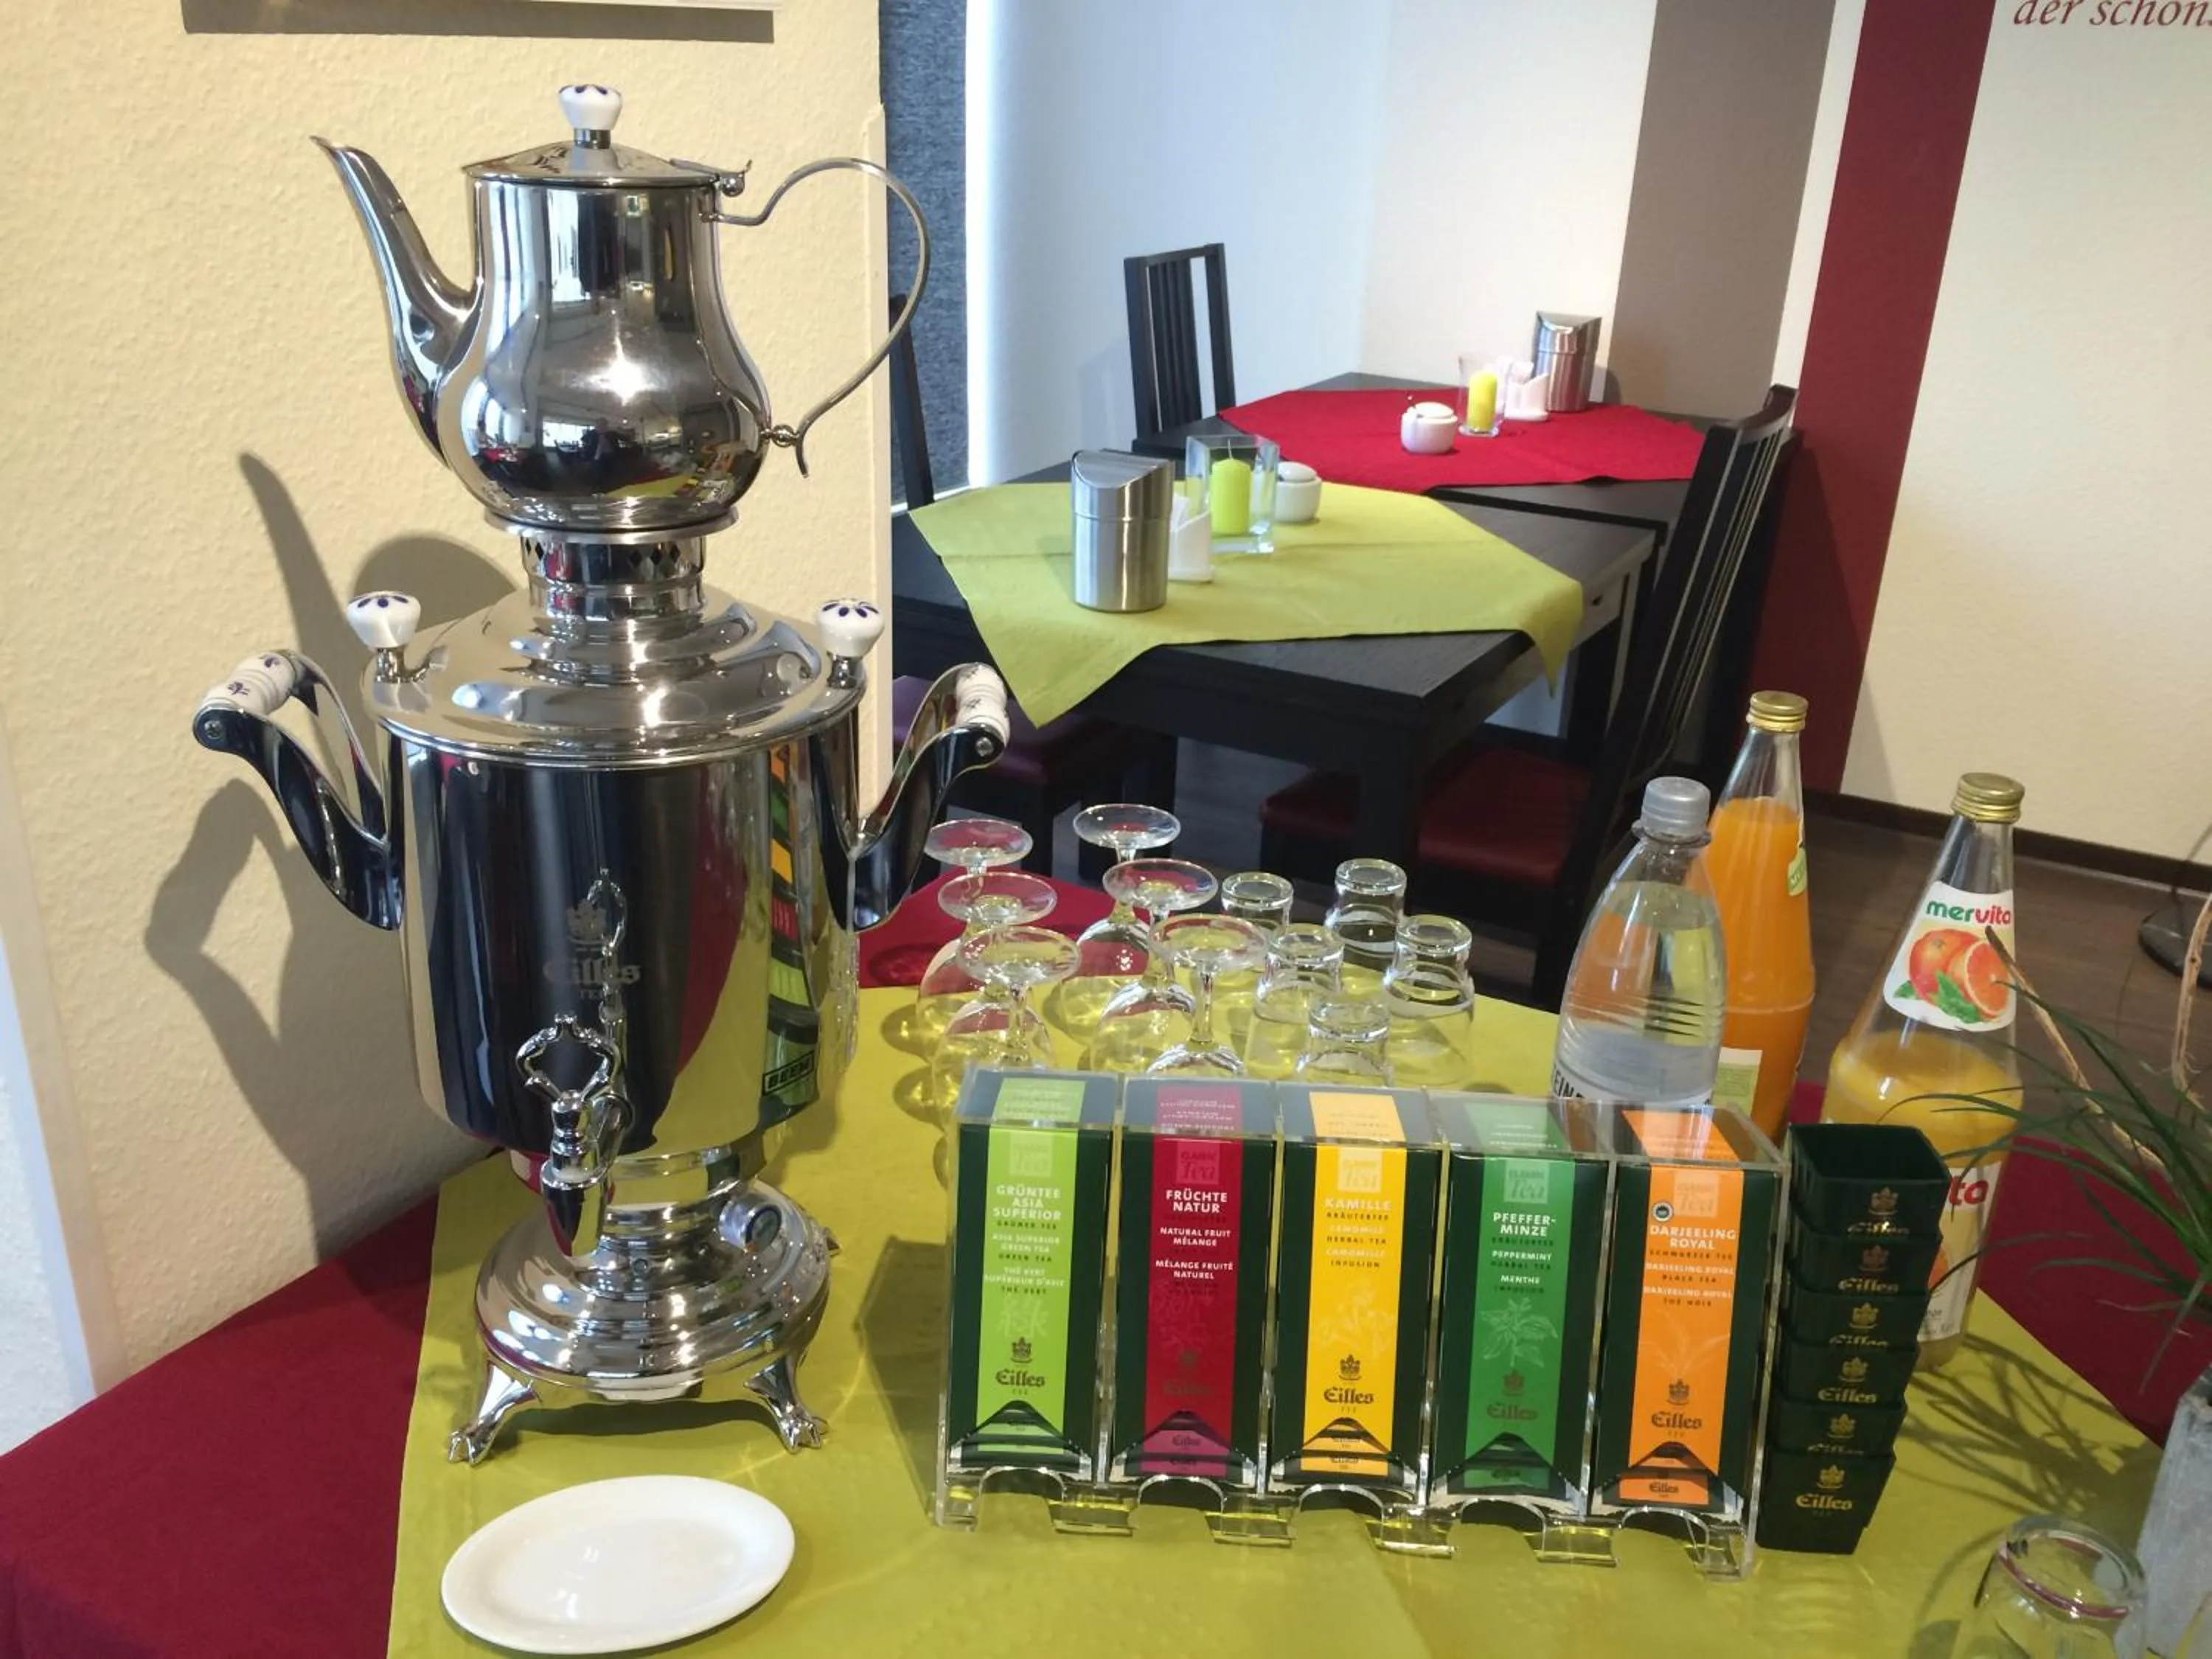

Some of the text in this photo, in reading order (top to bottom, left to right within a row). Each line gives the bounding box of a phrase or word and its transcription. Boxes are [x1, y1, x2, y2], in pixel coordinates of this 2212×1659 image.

[2014, 0, 2084, 25] der
[1926, 900, 2011, 925] mervita
[996, 1184, 1061, 1199] GRÜNTEE
[1166, 1188, 1228, 1203] FRÜCHTE
[1012, 1197, 1044, 1208] ASIA
[1173, 1201, 1220, 1213] NATUR
[1325, 1197, 1391, 1210] KAMILLE
[992, 1207, 1061, 1220] SUPERIOR
[1493, 1211, 1556, 1225] PFEFFER-
[1160, 1227, 1231, 1237] NATURAL FRUIT
[1500, 1224, 1548, 1236] MINZE
[1650, 1225, 1736, 1239] DARJEELING
[1173, 1237, 1217, 1246] MÉLANGE
[1670, 1238, 1714, 1250] ROYAL
[1492, 1250, 1552, 1260] PEPPERMINT
[1155, 1259, 1233, 1270] MÉLANGE FRUITÉ
[1173, 1270, 1214, 1279] NATUREL
[1500, 1275, 1540, 1284] MENTHE
[995, 1368, 1046, 1387] Eilles
[1324, 1386, 1374, 1405] Eilles
[1817, 1387, 1877, 1404] Eilles
[1486, 1402, 1538, 1421] Eilles
[1651, 1411, 1703, 1430] Eilles
[1795, 1493, 1853, 1511] Eilles
